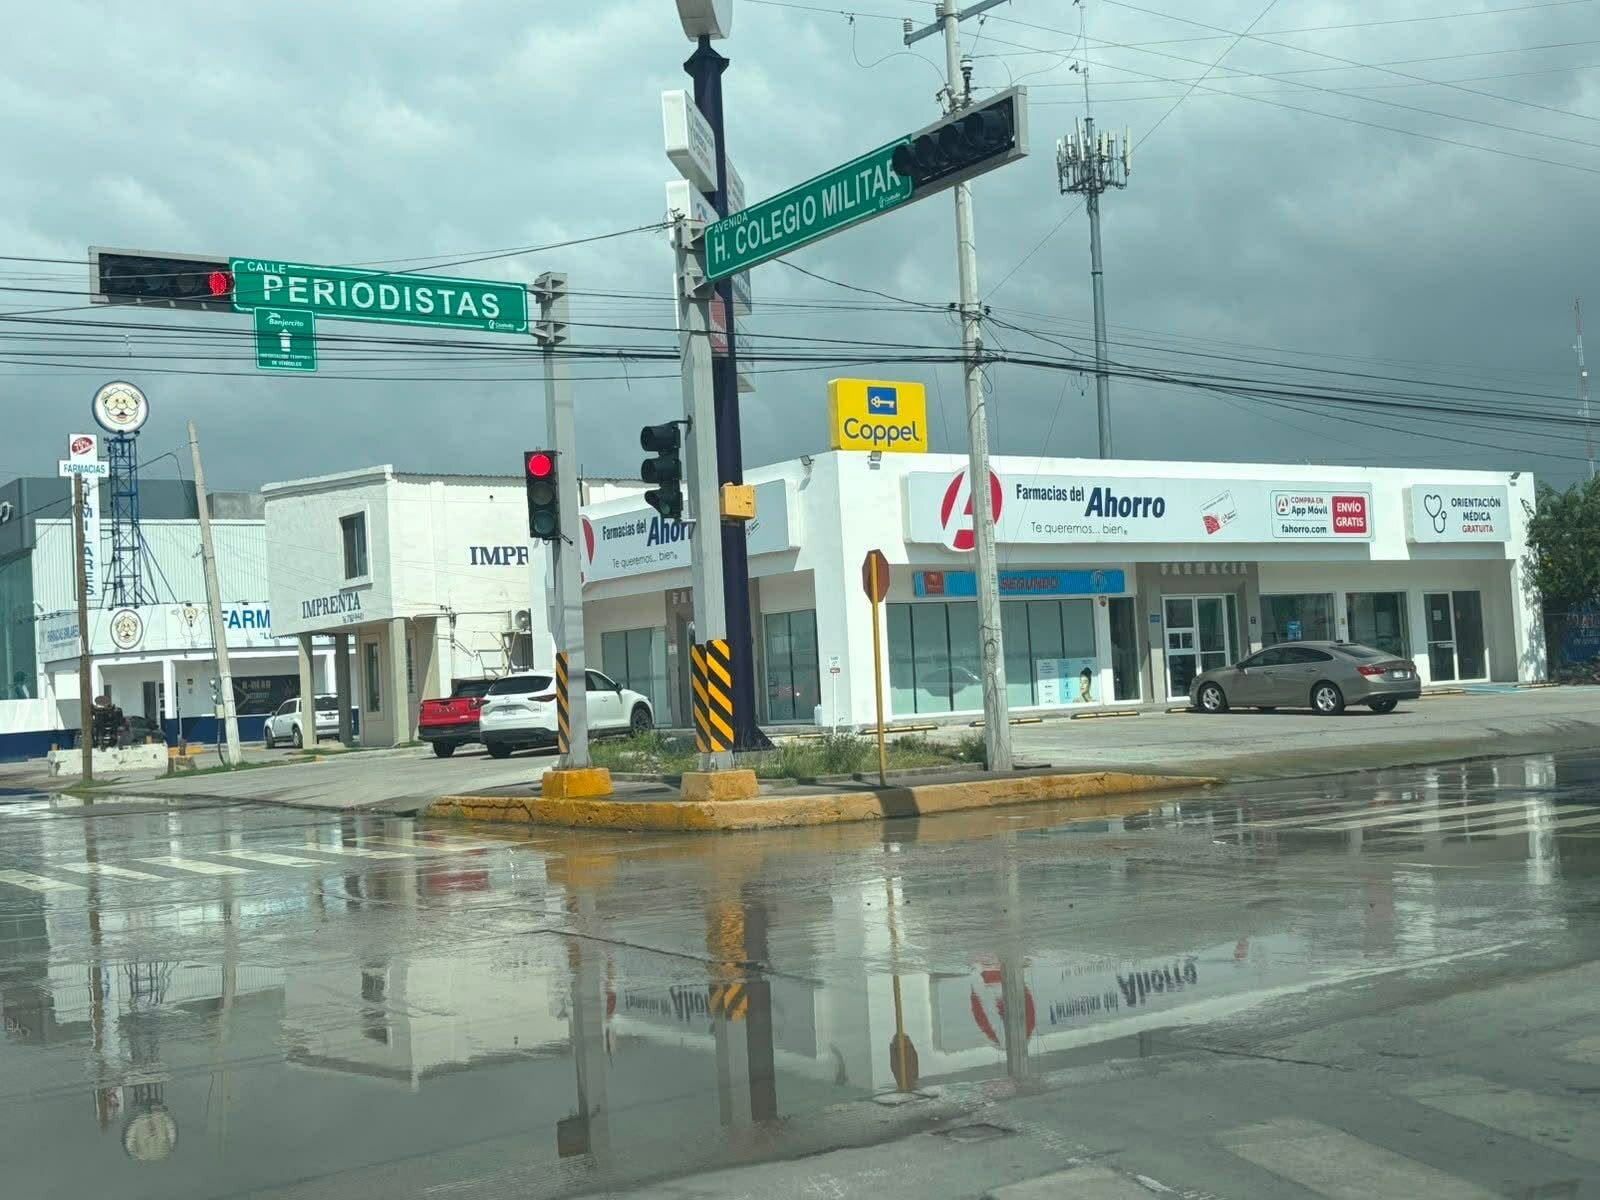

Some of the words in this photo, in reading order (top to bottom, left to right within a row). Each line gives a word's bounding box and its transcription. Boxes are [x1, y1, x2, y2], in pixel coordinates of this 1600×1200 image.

[714, 234, 731, 264] H.
[735, 195, 817, 254] COLEGIO
[821, 157, 902, 219] MILITAR
[714, 211, 748, 235] AVENIDA
[247, 261, 287, 275] CALLE
[263, 274, 500, 319] PERIODISTAS
[844, 417, 920, 447] Coppel
[63, 463, 106, 474] FARMACIAS
[1016, 483, 1068, 502] Farmacias
[1069, 485, 1085, 502] del
[1084, 487, 1166, 519] Ahorro
[1291, 497, 1314, 505] COMPRA
[1315, 497, 1324, 505] EN
[1451, 497, 1501, 508] ORIENTACIÓN
[1291, 505, 1306, 516] App
[1307, 505, 1328, 515] Móvil
[1337, 502, 1362, 513] ENVÍO
[1336, 516, 1364, 528] GRATIS
[1463, 511, 1492, 521] MÉDICA
[602, 522, 636, 541] Farmacias
[636, 518, 647, 534] del
[1031, 521, 1043, 534] Te
[1044, 523, 1101, 537] queremos...
[1282, 524, 1327, 534] fahorro.com
[1462, 524, 1494, 533] GRATUITA
[612, 557, 620, 569] Te
[302, 591, 362, 620] IMPRENTA
